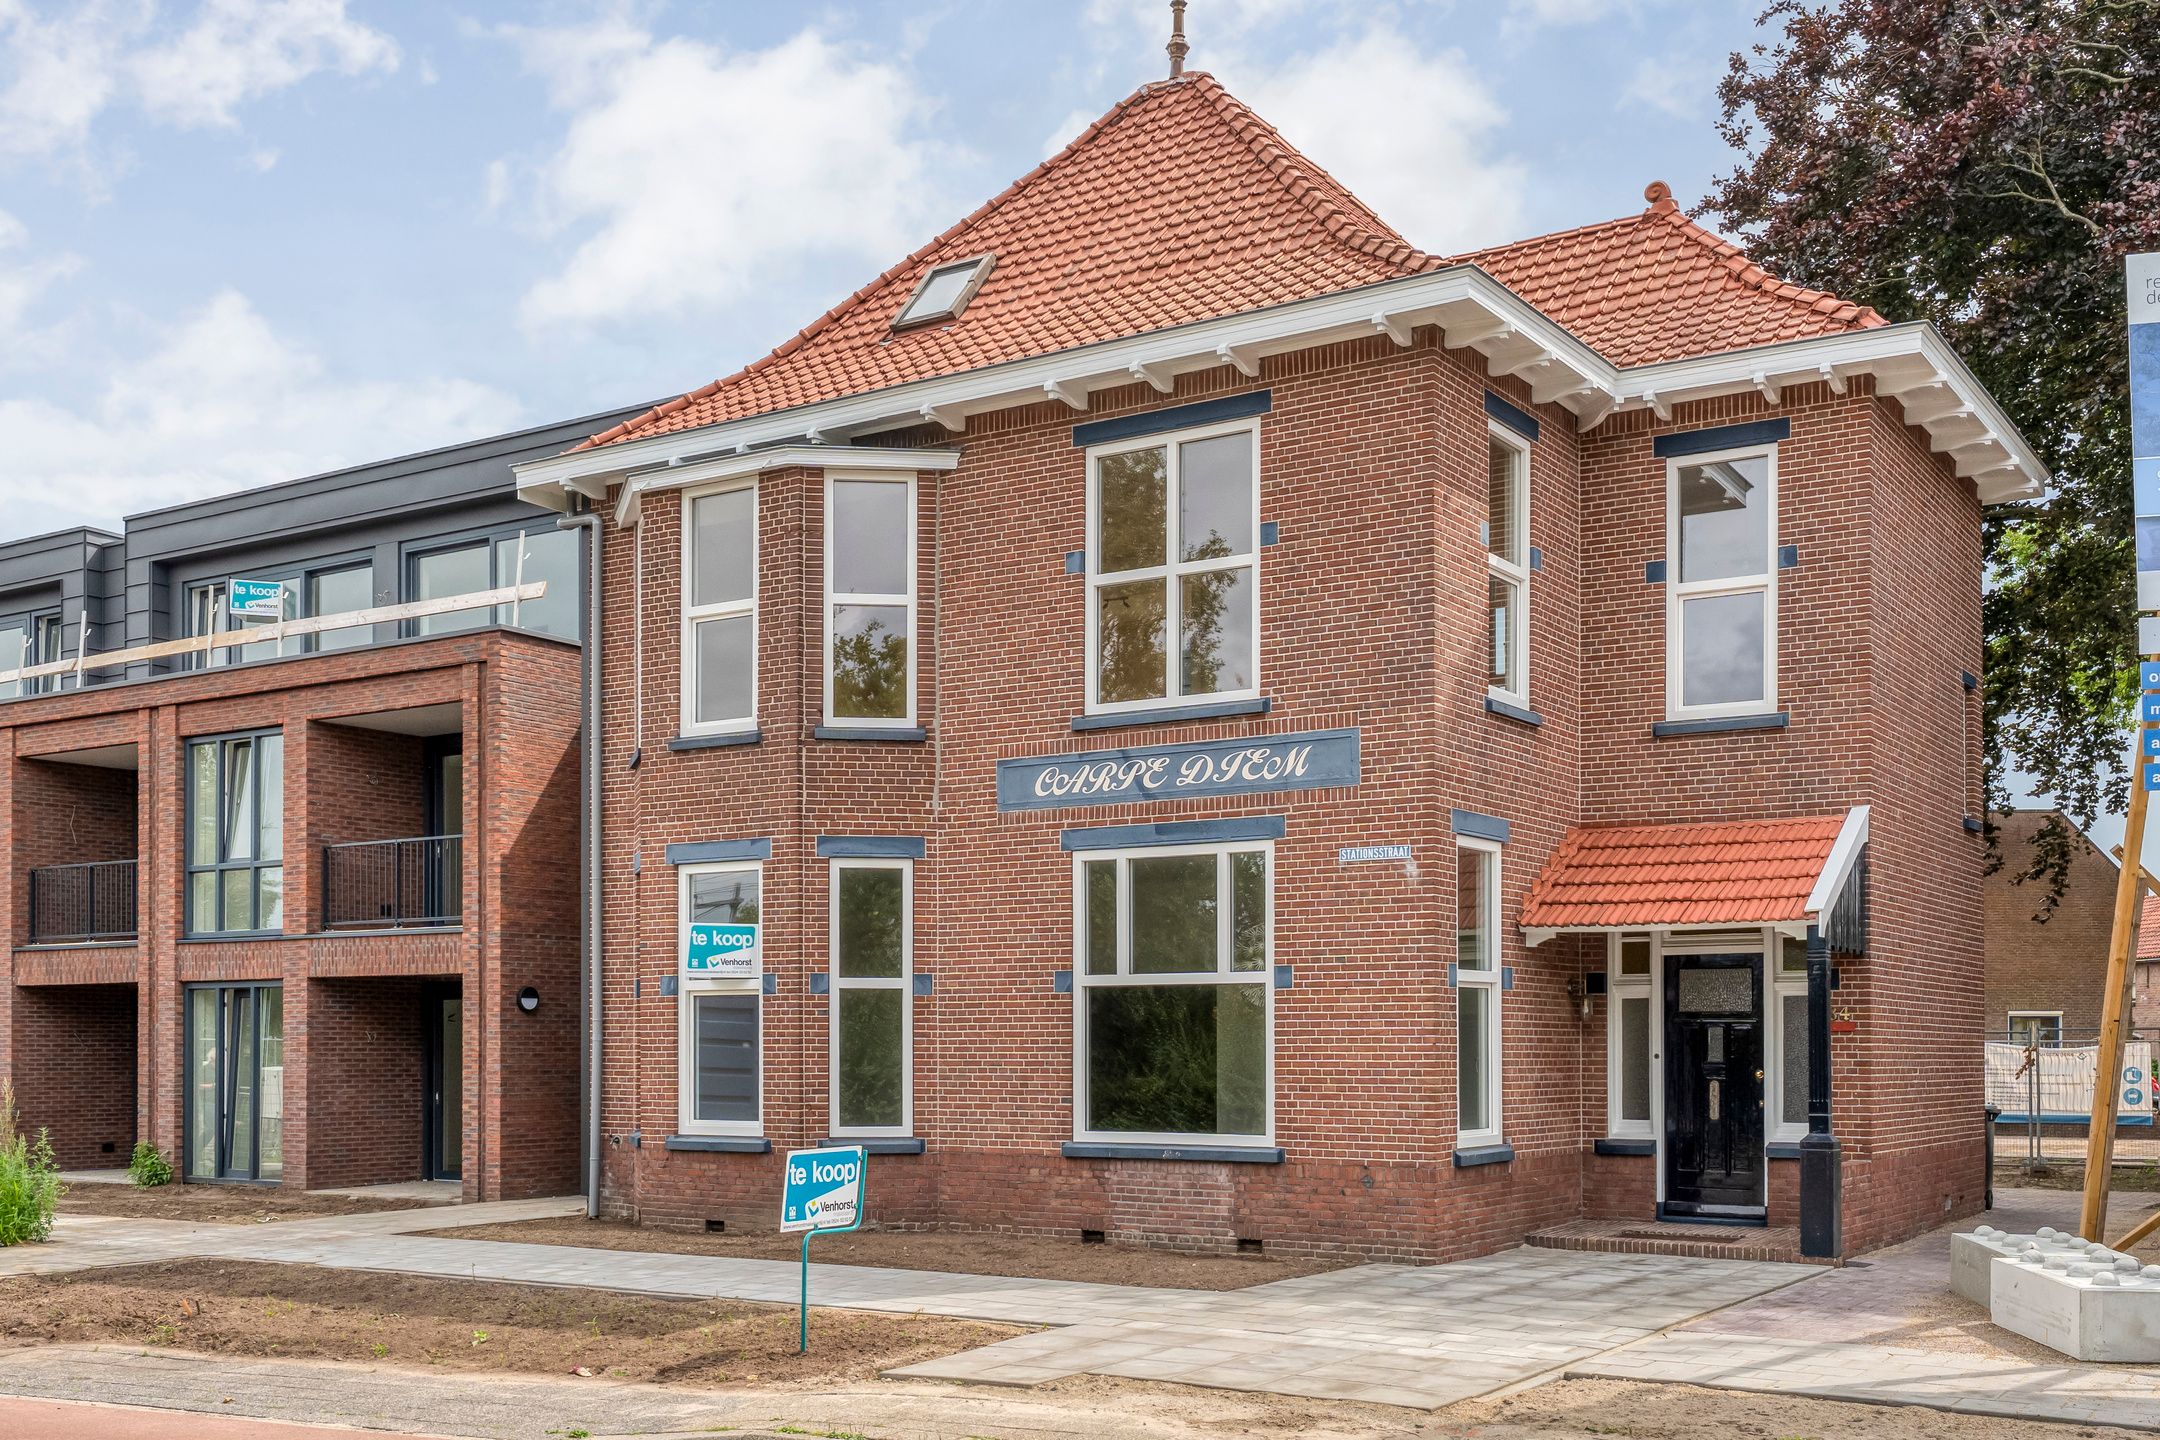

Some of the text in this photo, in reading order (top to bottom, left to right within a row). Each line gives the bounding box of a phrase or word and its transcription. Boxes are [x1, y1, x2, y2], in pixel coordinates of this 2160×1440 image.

[234, 584, 279, 598] te koop
[1034, 745, 1313, 797] CARPE DIEM
[1341, 846, 1409, 860] STATIONSSTRAAT
[691, 930, 753, 949] te koop
[720, 958, 752, 966] Venhorst
[789, 1160, 856, 1186] te koop
[820, 1199, 854, 1212] Venhorst
